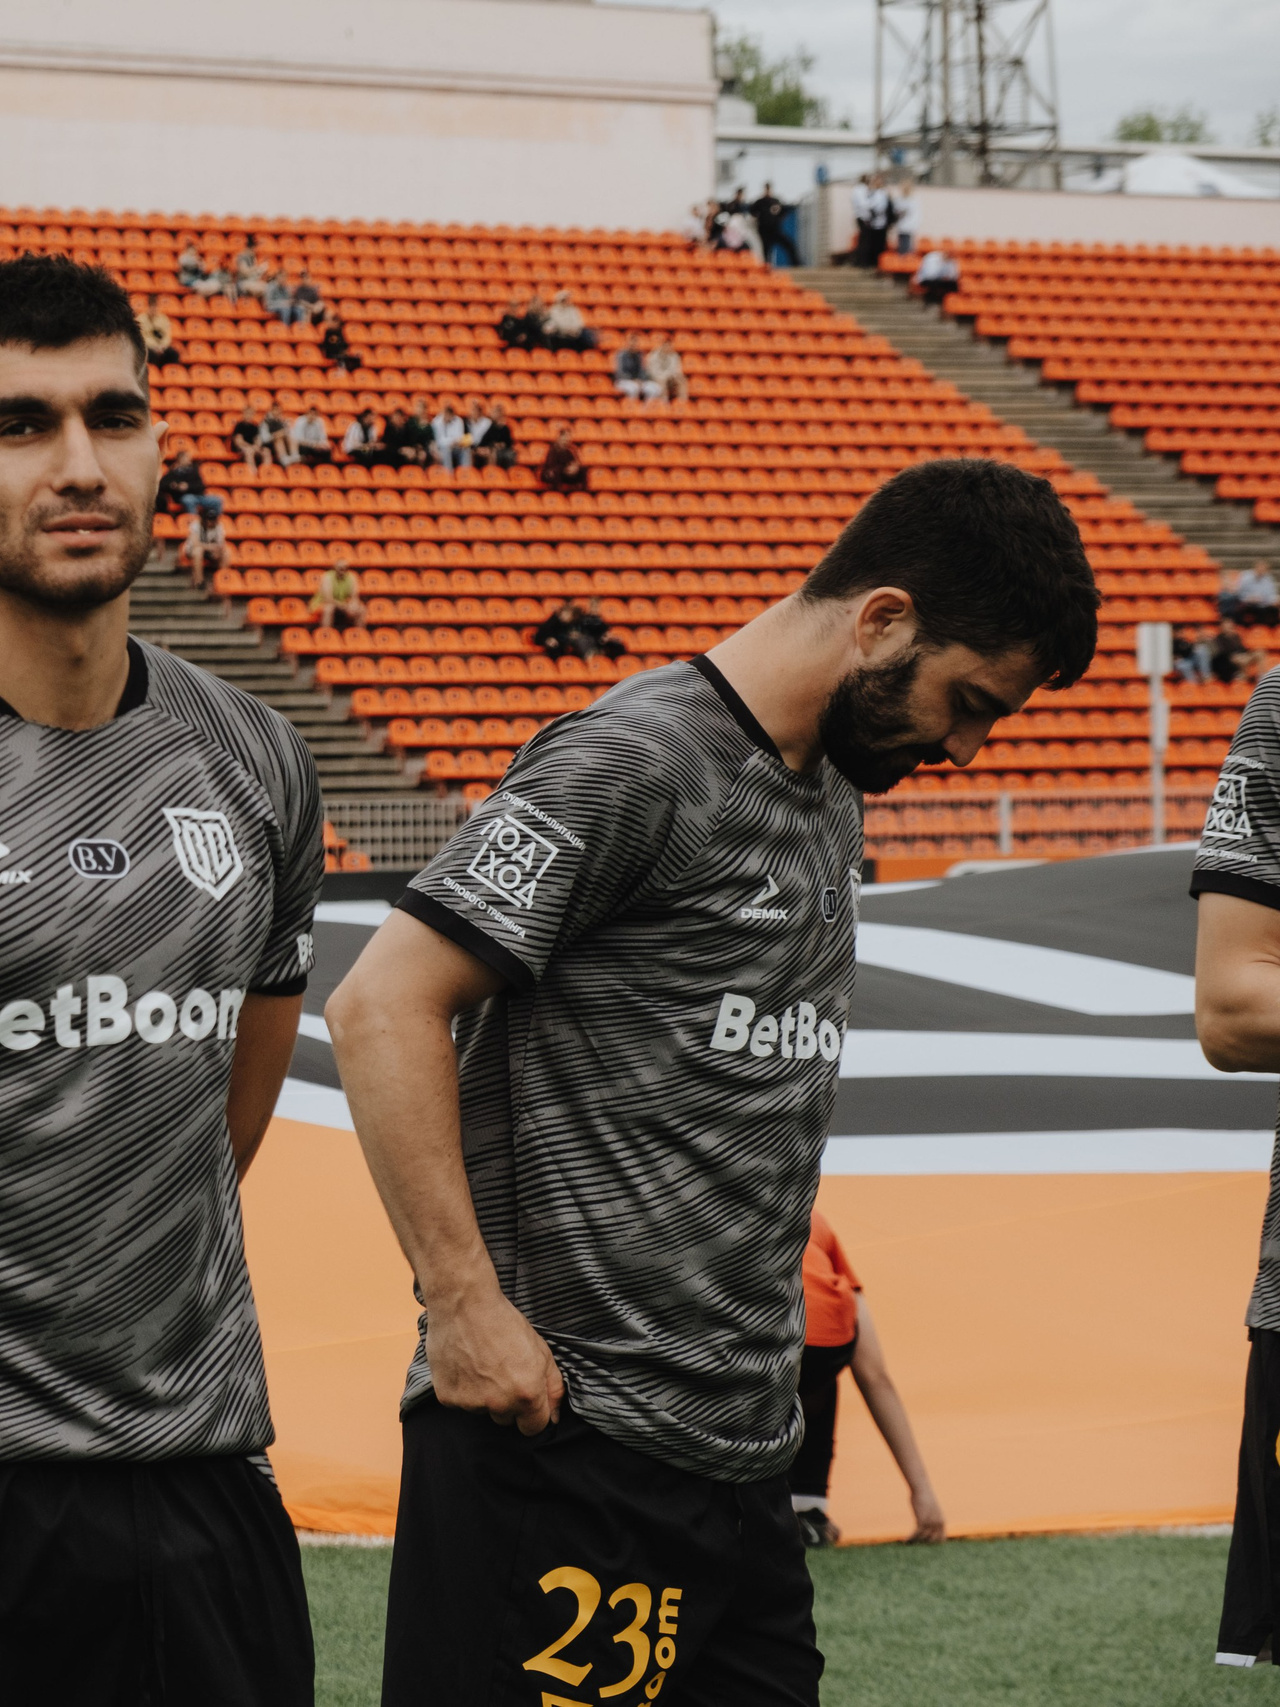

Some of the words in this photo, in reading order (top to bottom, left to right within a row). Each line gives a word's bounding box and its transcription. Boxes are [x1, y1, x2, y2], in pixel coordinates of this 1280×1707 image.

[480, 817, 537, 872] ПОД
[442, 876, 488, 911] СИЛОВОГО
[486, 905, 527, 939] ТРЕНИНГА
[478, 850, 538, 910] ХОД
[740, 908, 788, 920] DEMIX
[709, 993, 847, 1062] BetBo
[522, 1566, 652, 1698] 23
